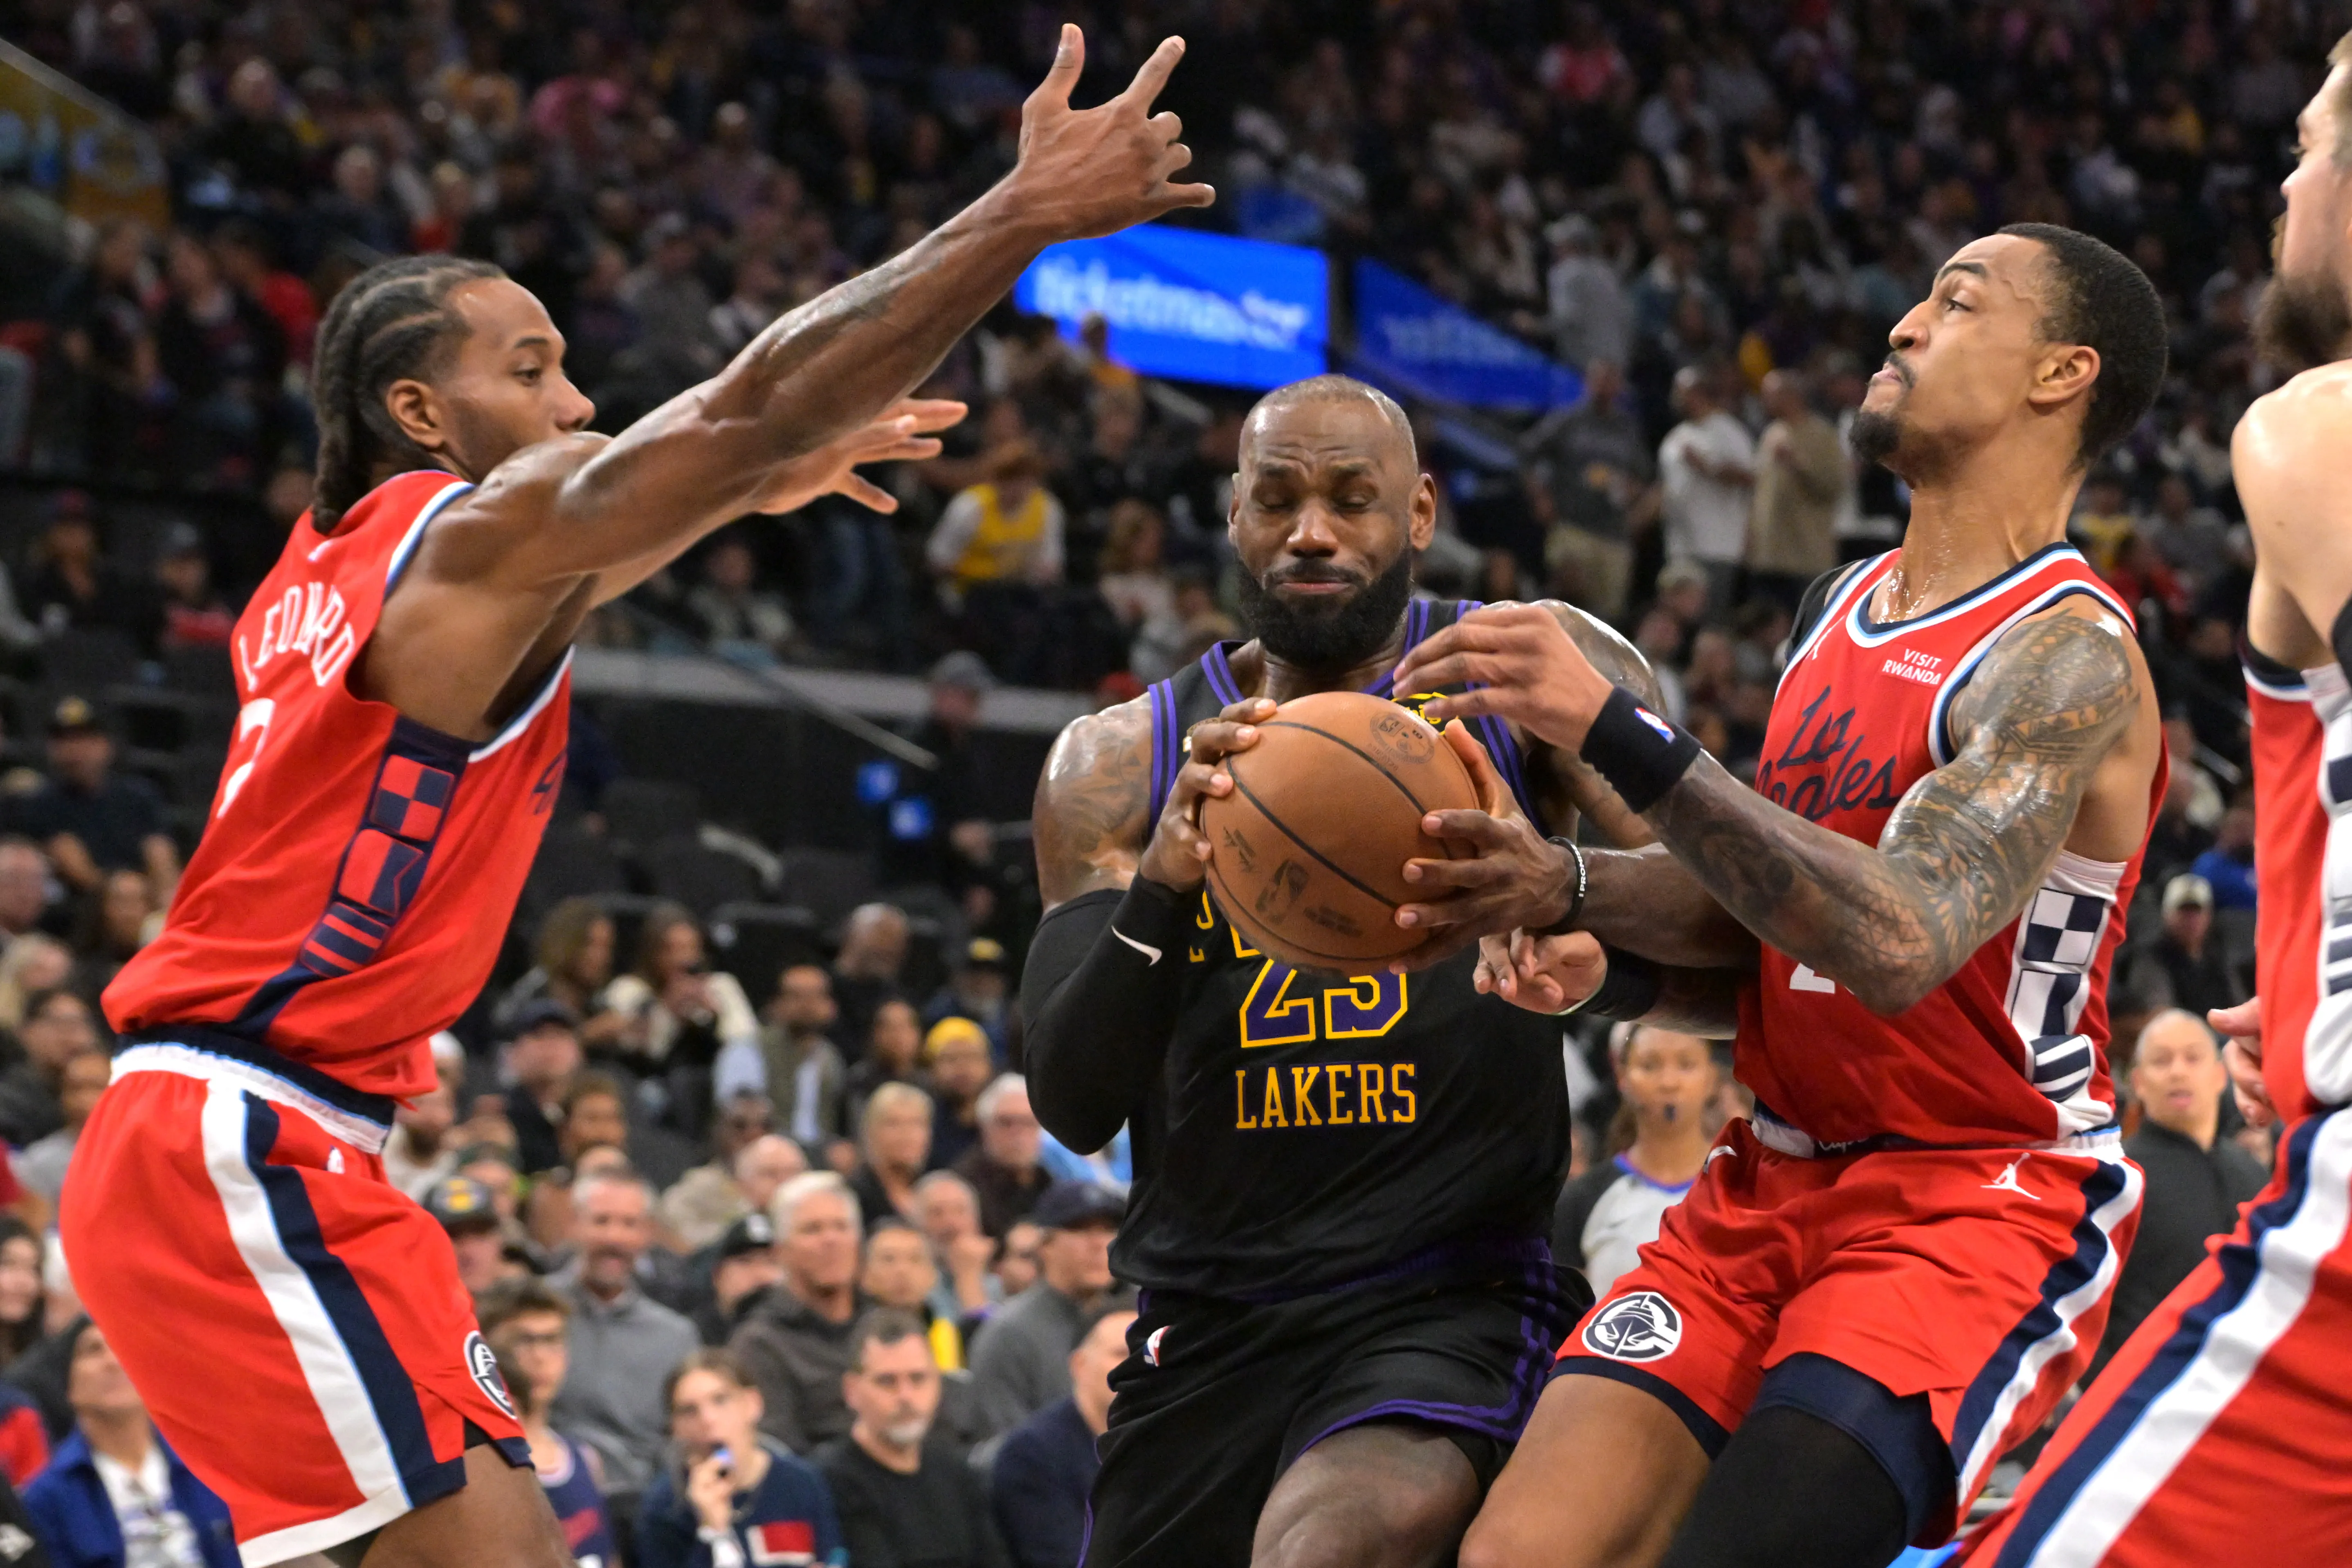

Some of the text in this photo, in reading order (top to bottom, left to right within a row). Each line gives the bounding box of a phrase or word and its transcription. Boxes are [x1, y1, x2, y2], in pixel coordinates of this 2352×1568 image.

[238, 581, 355, 692] LEONRD
[1903, 648, 1942, 669] VISIT
[1882, 659, 1942, 685] RWANDA
[1776, 685, 1856, 771] Los
[1235, 1063, 1416, 1129] LAKERS
